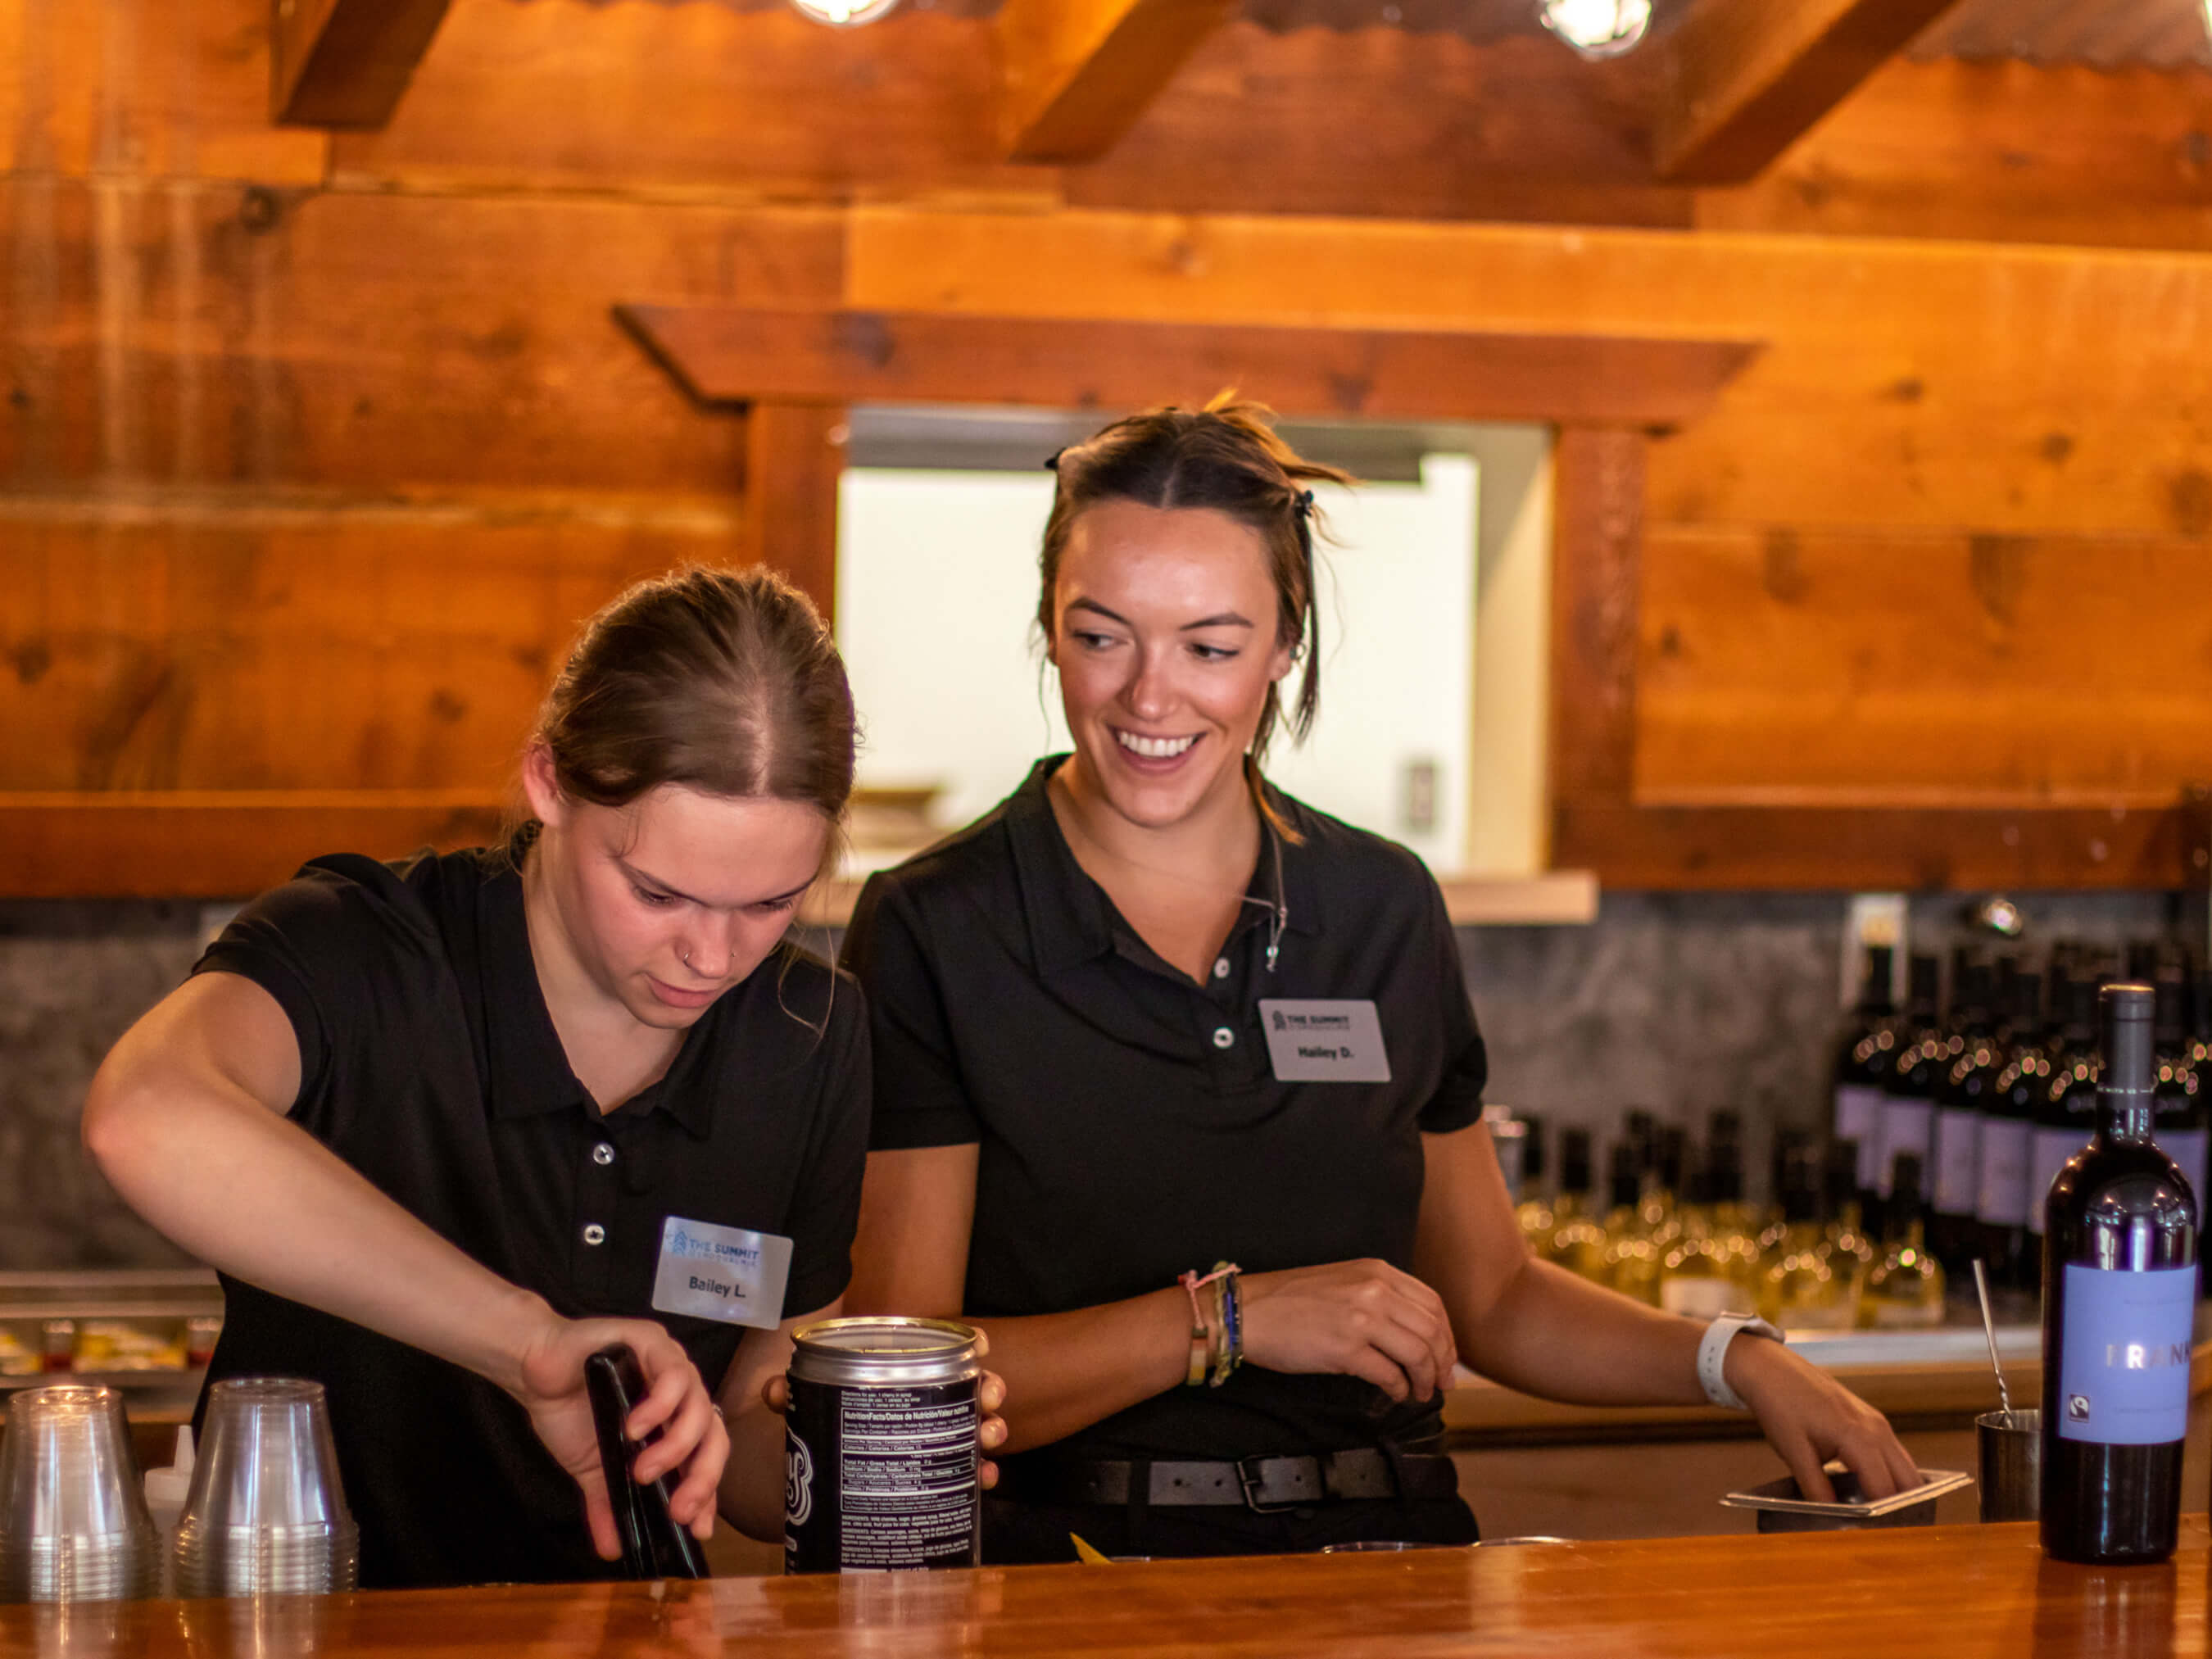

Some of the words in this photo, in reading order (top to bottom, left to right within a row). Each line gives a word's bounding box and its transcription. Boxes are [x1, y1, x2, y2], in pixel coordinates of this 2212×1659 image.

[1287, 1015, 1307, 1024] THE
[1310, 1015, 1349, 1024] SUMMIT
[1298, 1046, 1337, 1061] Hailey
[689, 1238, 711, 1252] THE
[714, 1244, 759, 1259] SUMMIT
[689, 1276, 731, 1298] Bailey
[734, 1285, 746, 1298] L.
